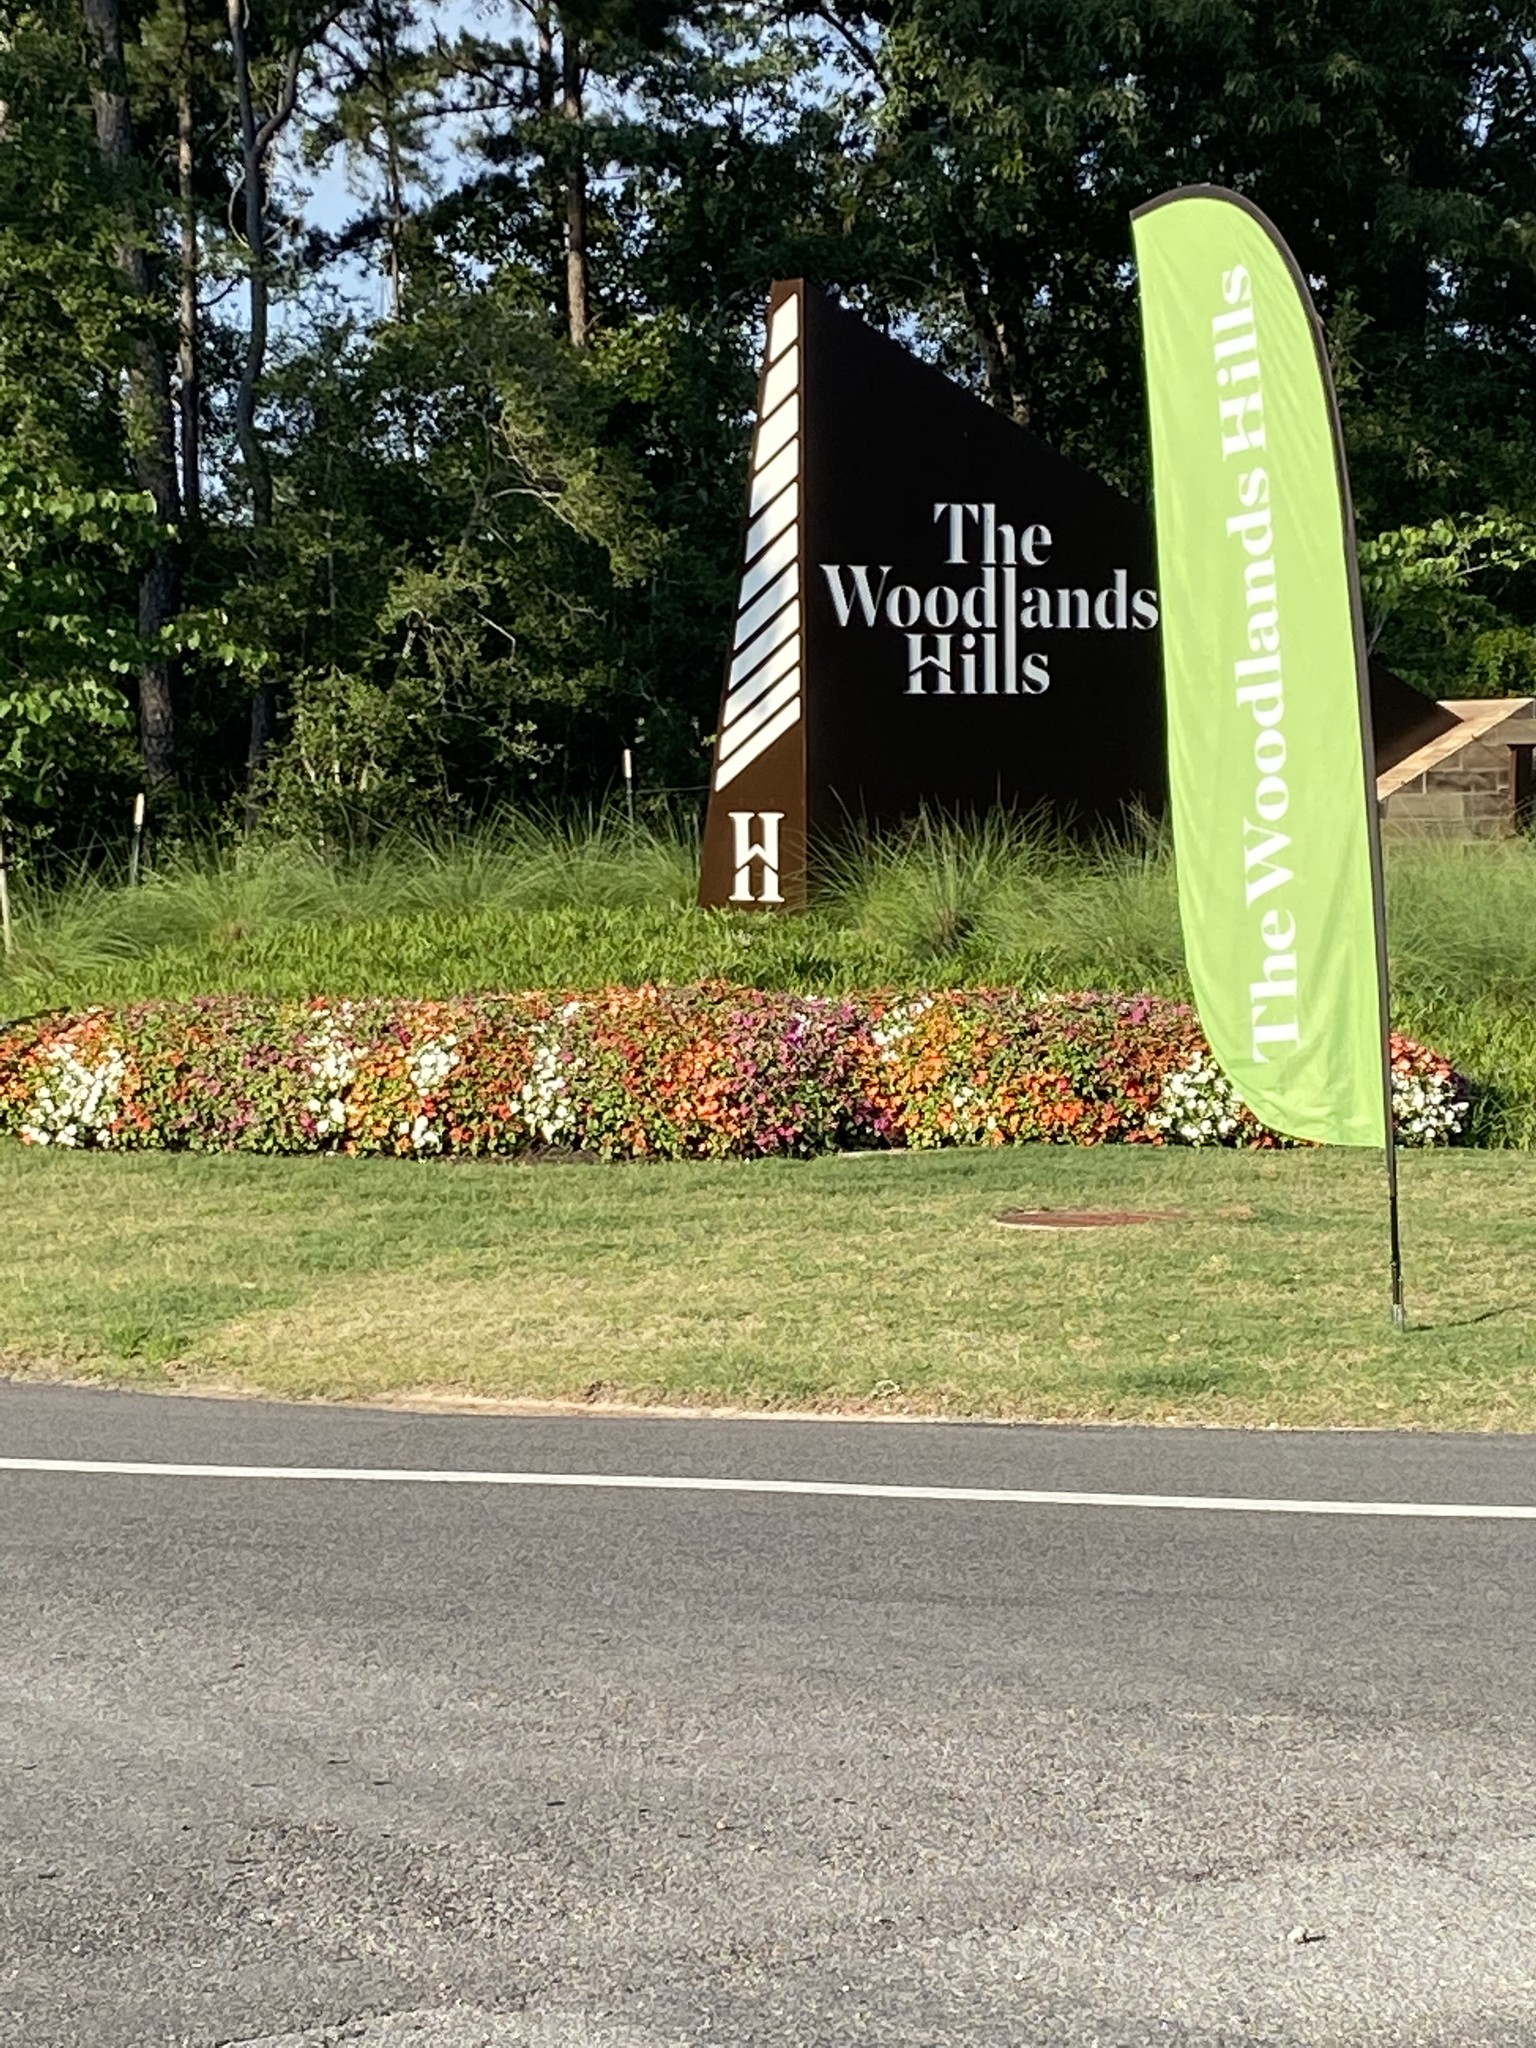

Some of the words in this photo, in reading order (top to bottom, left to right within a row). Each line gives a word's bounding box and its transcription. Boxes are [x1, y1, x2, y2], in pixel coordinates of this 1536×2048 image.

[1211, 264, 1268, 460] Hills
[935, 503, 1052, 566] The
[820, 564, 1159, 630] Woodlands
[904, 634, 1050, 695] Hills
[1225, 467, 1294, 911] Woodlands
[1250, 908, 1302, 1062] The
